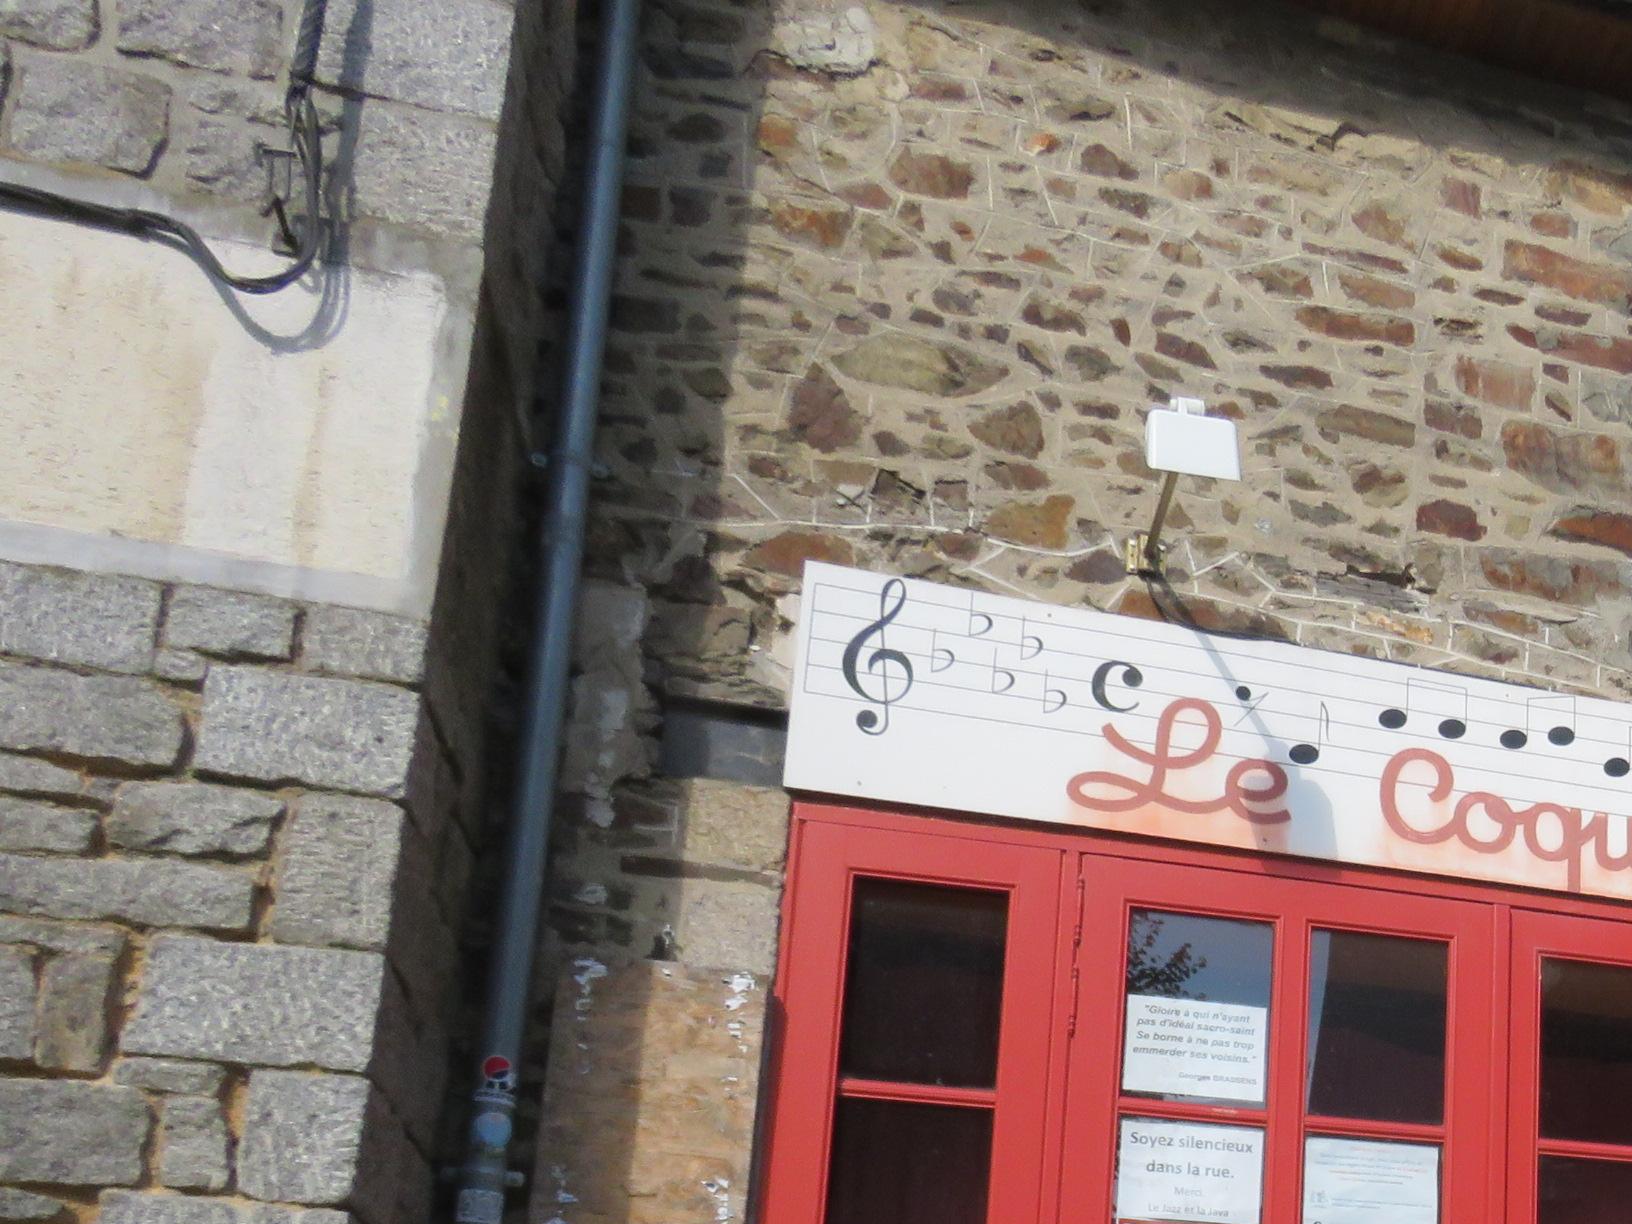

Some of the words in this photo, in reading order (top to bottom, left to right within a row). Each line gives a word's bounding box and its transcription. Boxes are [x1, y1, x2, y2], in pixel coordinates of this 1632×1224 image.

[1066, 697, 1291, 825] Le
[1193, 1010, 1209, 1021] qui
[1136, 1017, 1156, 1028] pas
[1197, 1023, 1255, 1036] sacro-saint
[1136, 1030, 1150, 1040] Se
[1153, 1031, 1184, 1043] borne
[1187, 1035, 1192, 1044] à
[1196, 1037, 1209, 1046] ne
[1211, 1039, 1230, 1049] pas
[1233, 1041, 1255, 1051] trop
[1132, 1046, 1187, 1058] emmerder
[1130, 1131, 1175, 1149] Soyez
[1178, 1135, 1253, 1153] silencieux
[1146, 1159, 1183, 1175] dans
[1187, 1162, 1200, 1176] la
[1205, 1167, 1235, 1179] rue.
[1148, 1203, 1160, 1212] Le
[1162, 1204, 1181, 1214] Jazz
[1184, 1205, 1194, 1215] et
[1196, 1206, 1206, 1216] la
[1207, 1207, 1229, 1218] Java
